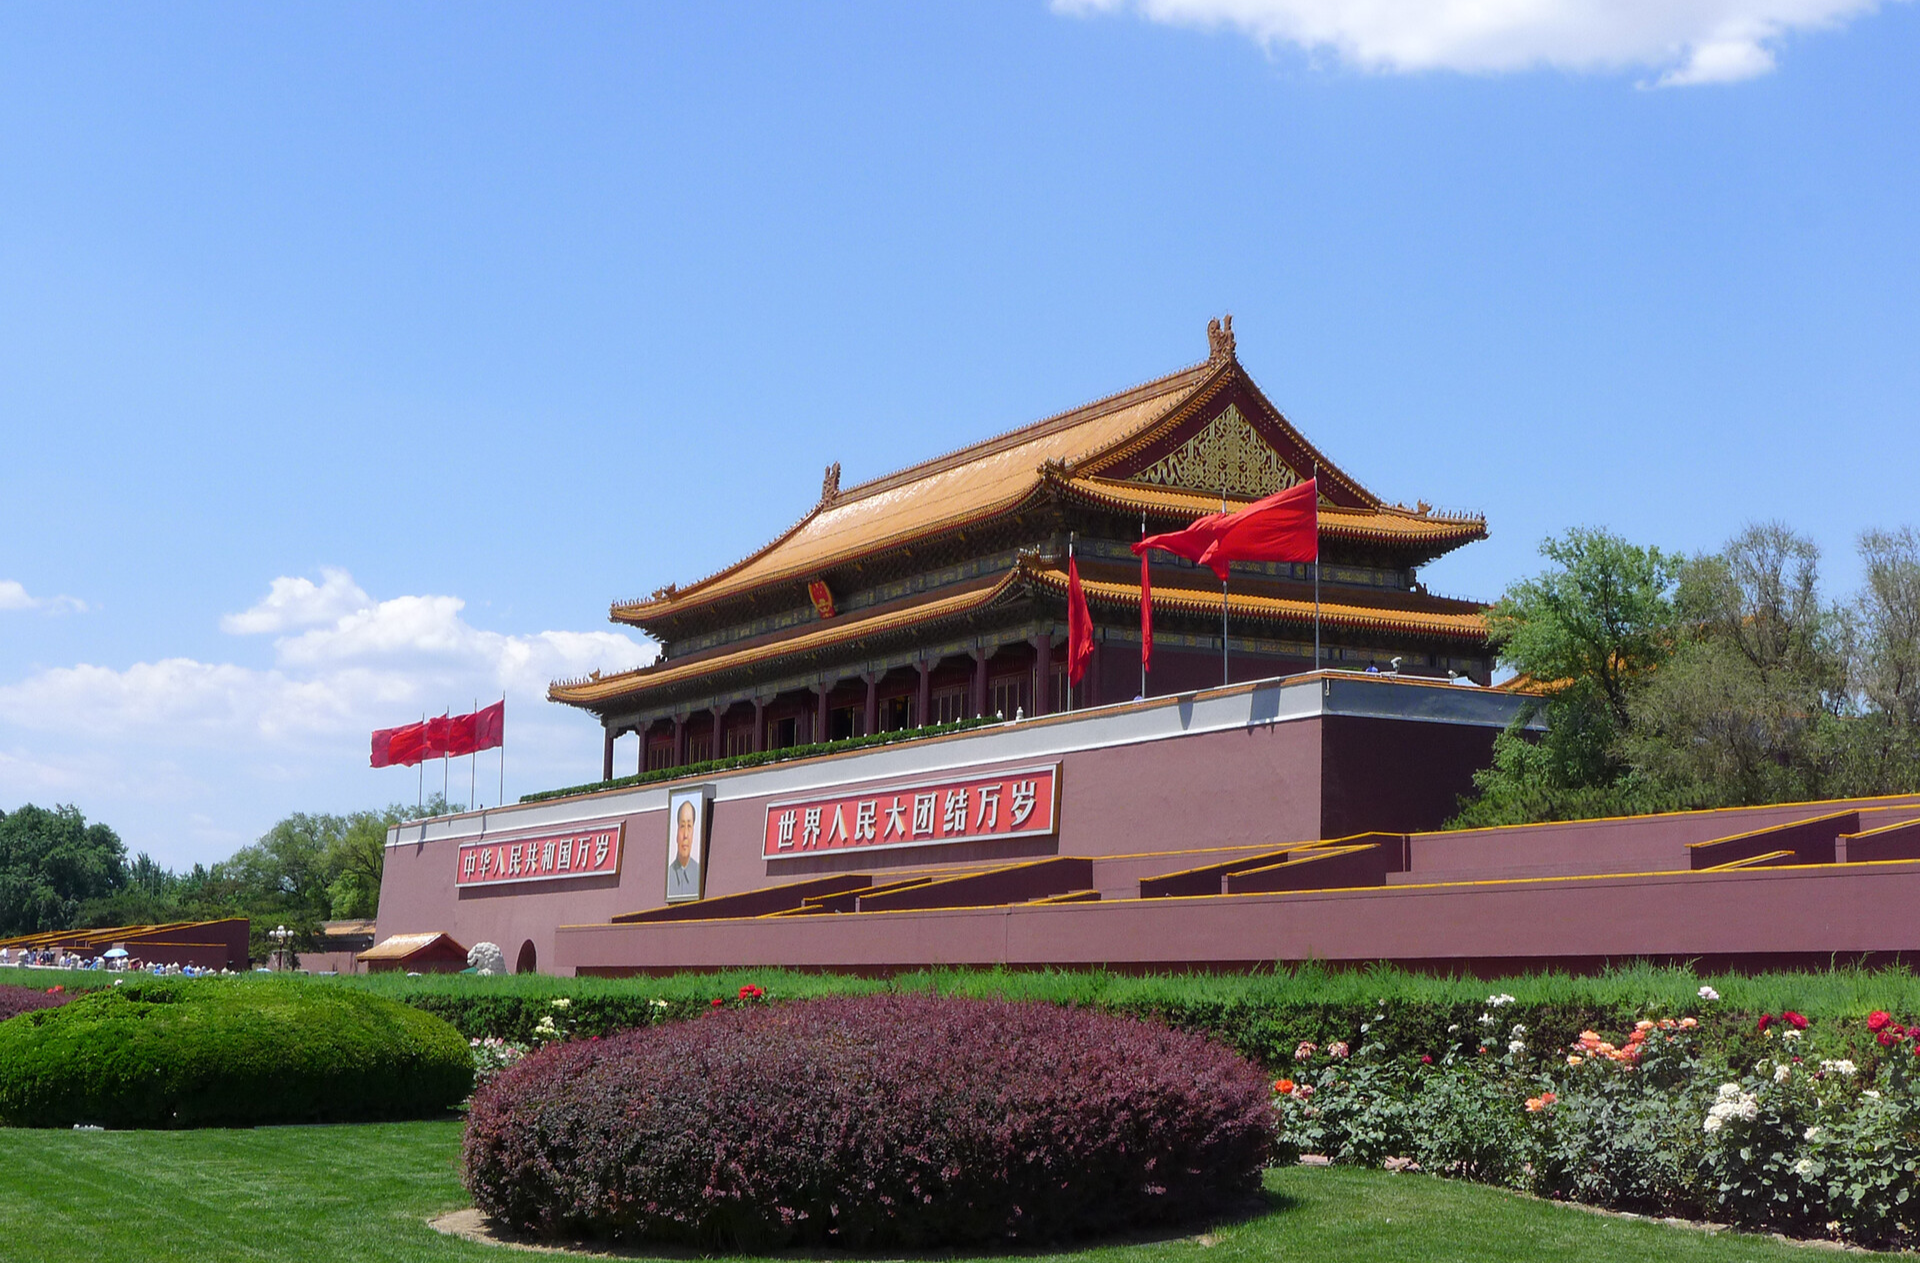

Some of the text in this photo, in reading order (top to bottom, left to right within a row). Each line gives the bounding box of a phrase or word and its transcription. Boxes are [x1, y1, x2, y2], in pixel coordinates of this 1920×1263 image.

[777, 780, 1037, 849] 世界人民大团结万岁
[463, 834, 610, 879] 中华人民共和国万岁
